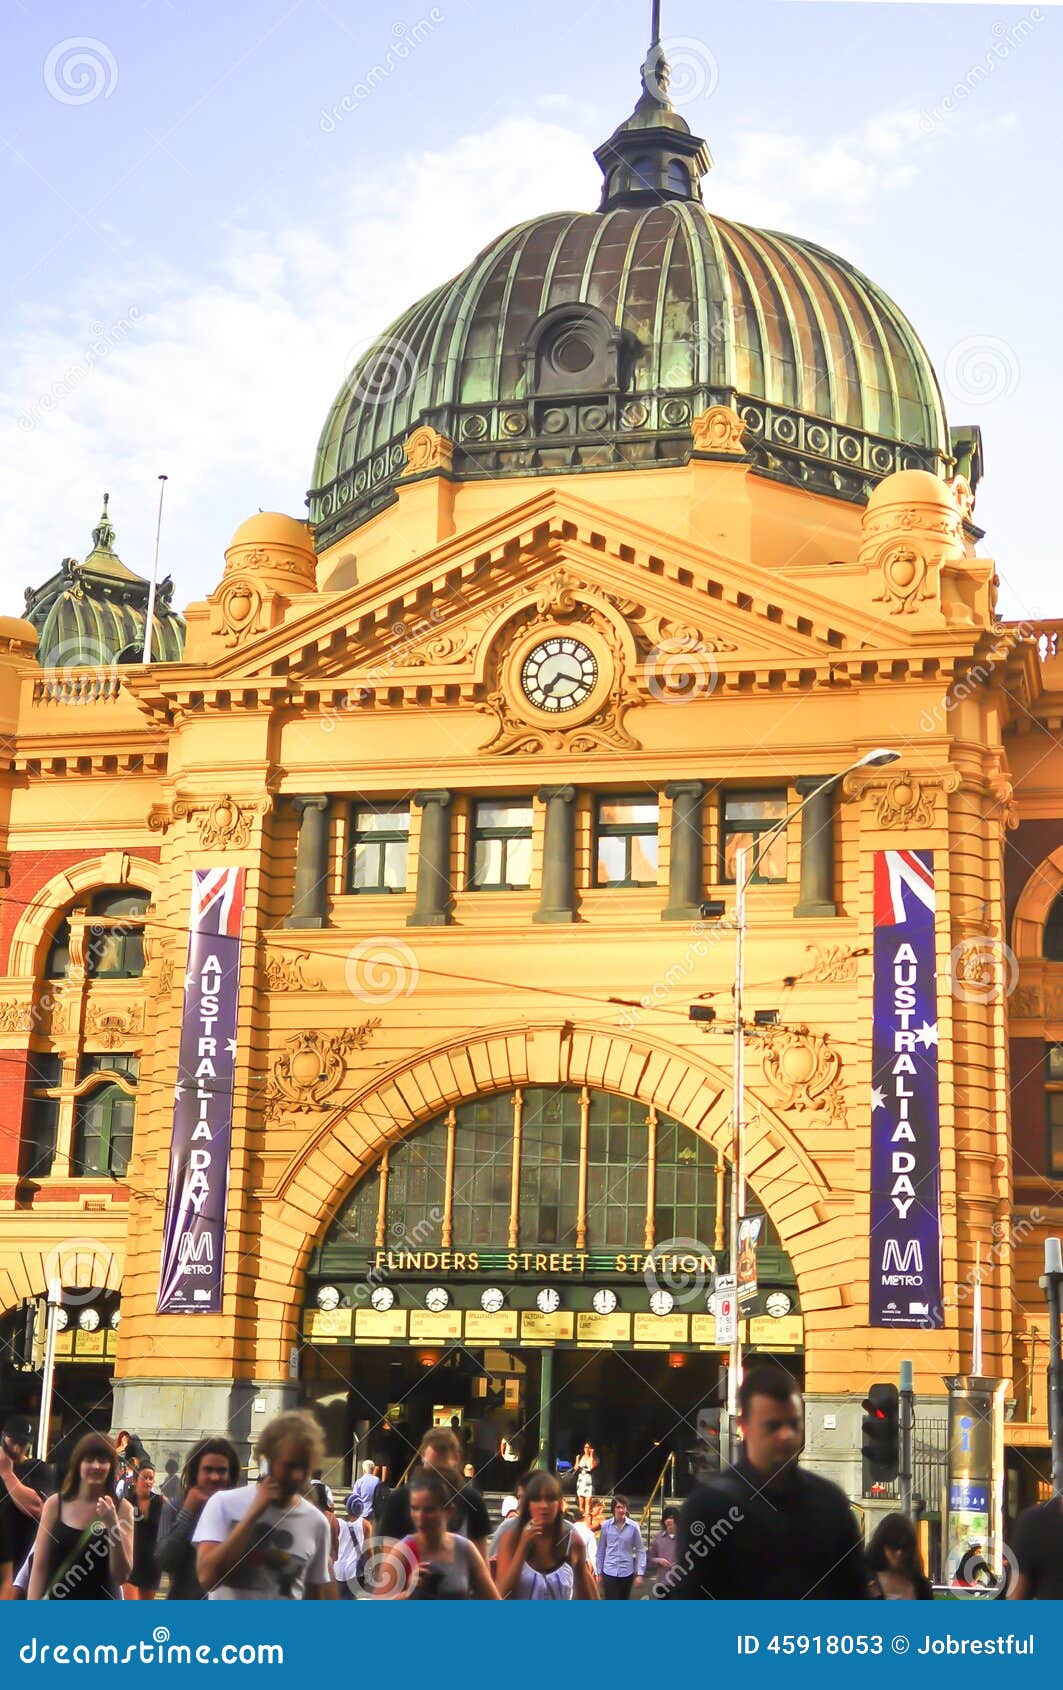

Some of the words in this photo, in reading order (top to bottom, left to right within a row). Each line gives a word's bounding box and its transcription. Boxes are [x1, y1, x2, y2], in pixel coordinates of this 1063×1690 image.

[191, 955, 222, 1140] AUSTRALIA
[891, 943, 918, 1142] AUSTRALIA
[189, 1150, 211, 1214] DAY
[891, 1152, 917, 1219] DAY
[375, 1251, 479, 1271] FLINDERS
[507, 1253, 589, 1272] STREET
[615, 1254, 716, 1273] STATION
[882, 1275, 923, 1286] METRO
